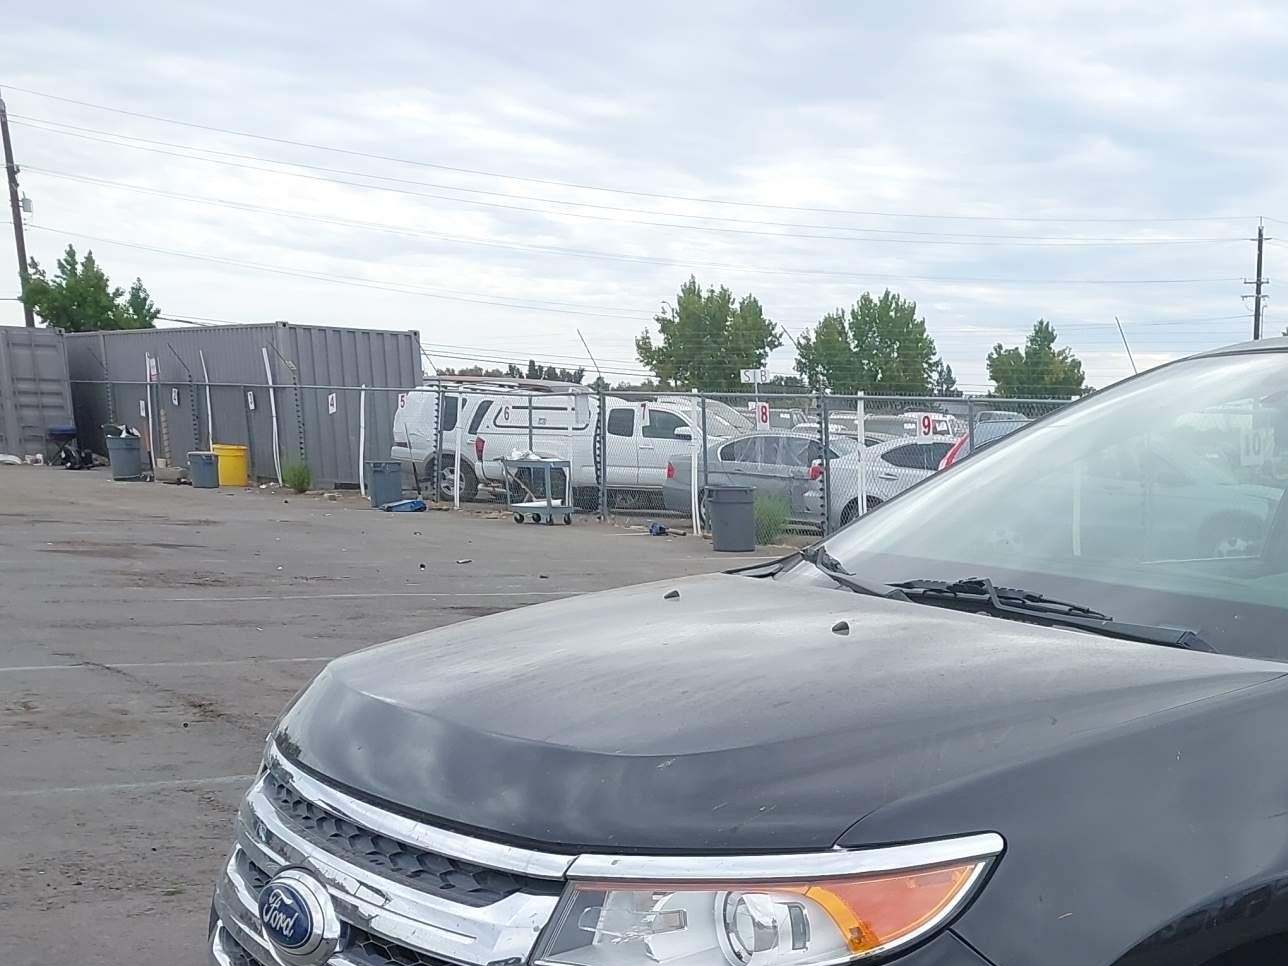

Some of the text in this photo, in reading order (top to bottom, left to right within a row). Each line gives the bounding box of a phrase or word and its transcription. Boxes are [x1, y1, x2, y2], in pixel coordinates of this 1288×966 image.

[329, 394, 336, 409] 4
[400, 395, 406, 408] 5
[504, 406, 510, 421] 6
[640, 403, 646, 419] 7
[761, 405, 768, 423] 8
[922, 415, 931, 436] 9
[1246, 432, 1261, 456] 10
[262, 888, 299, 938] Ford
